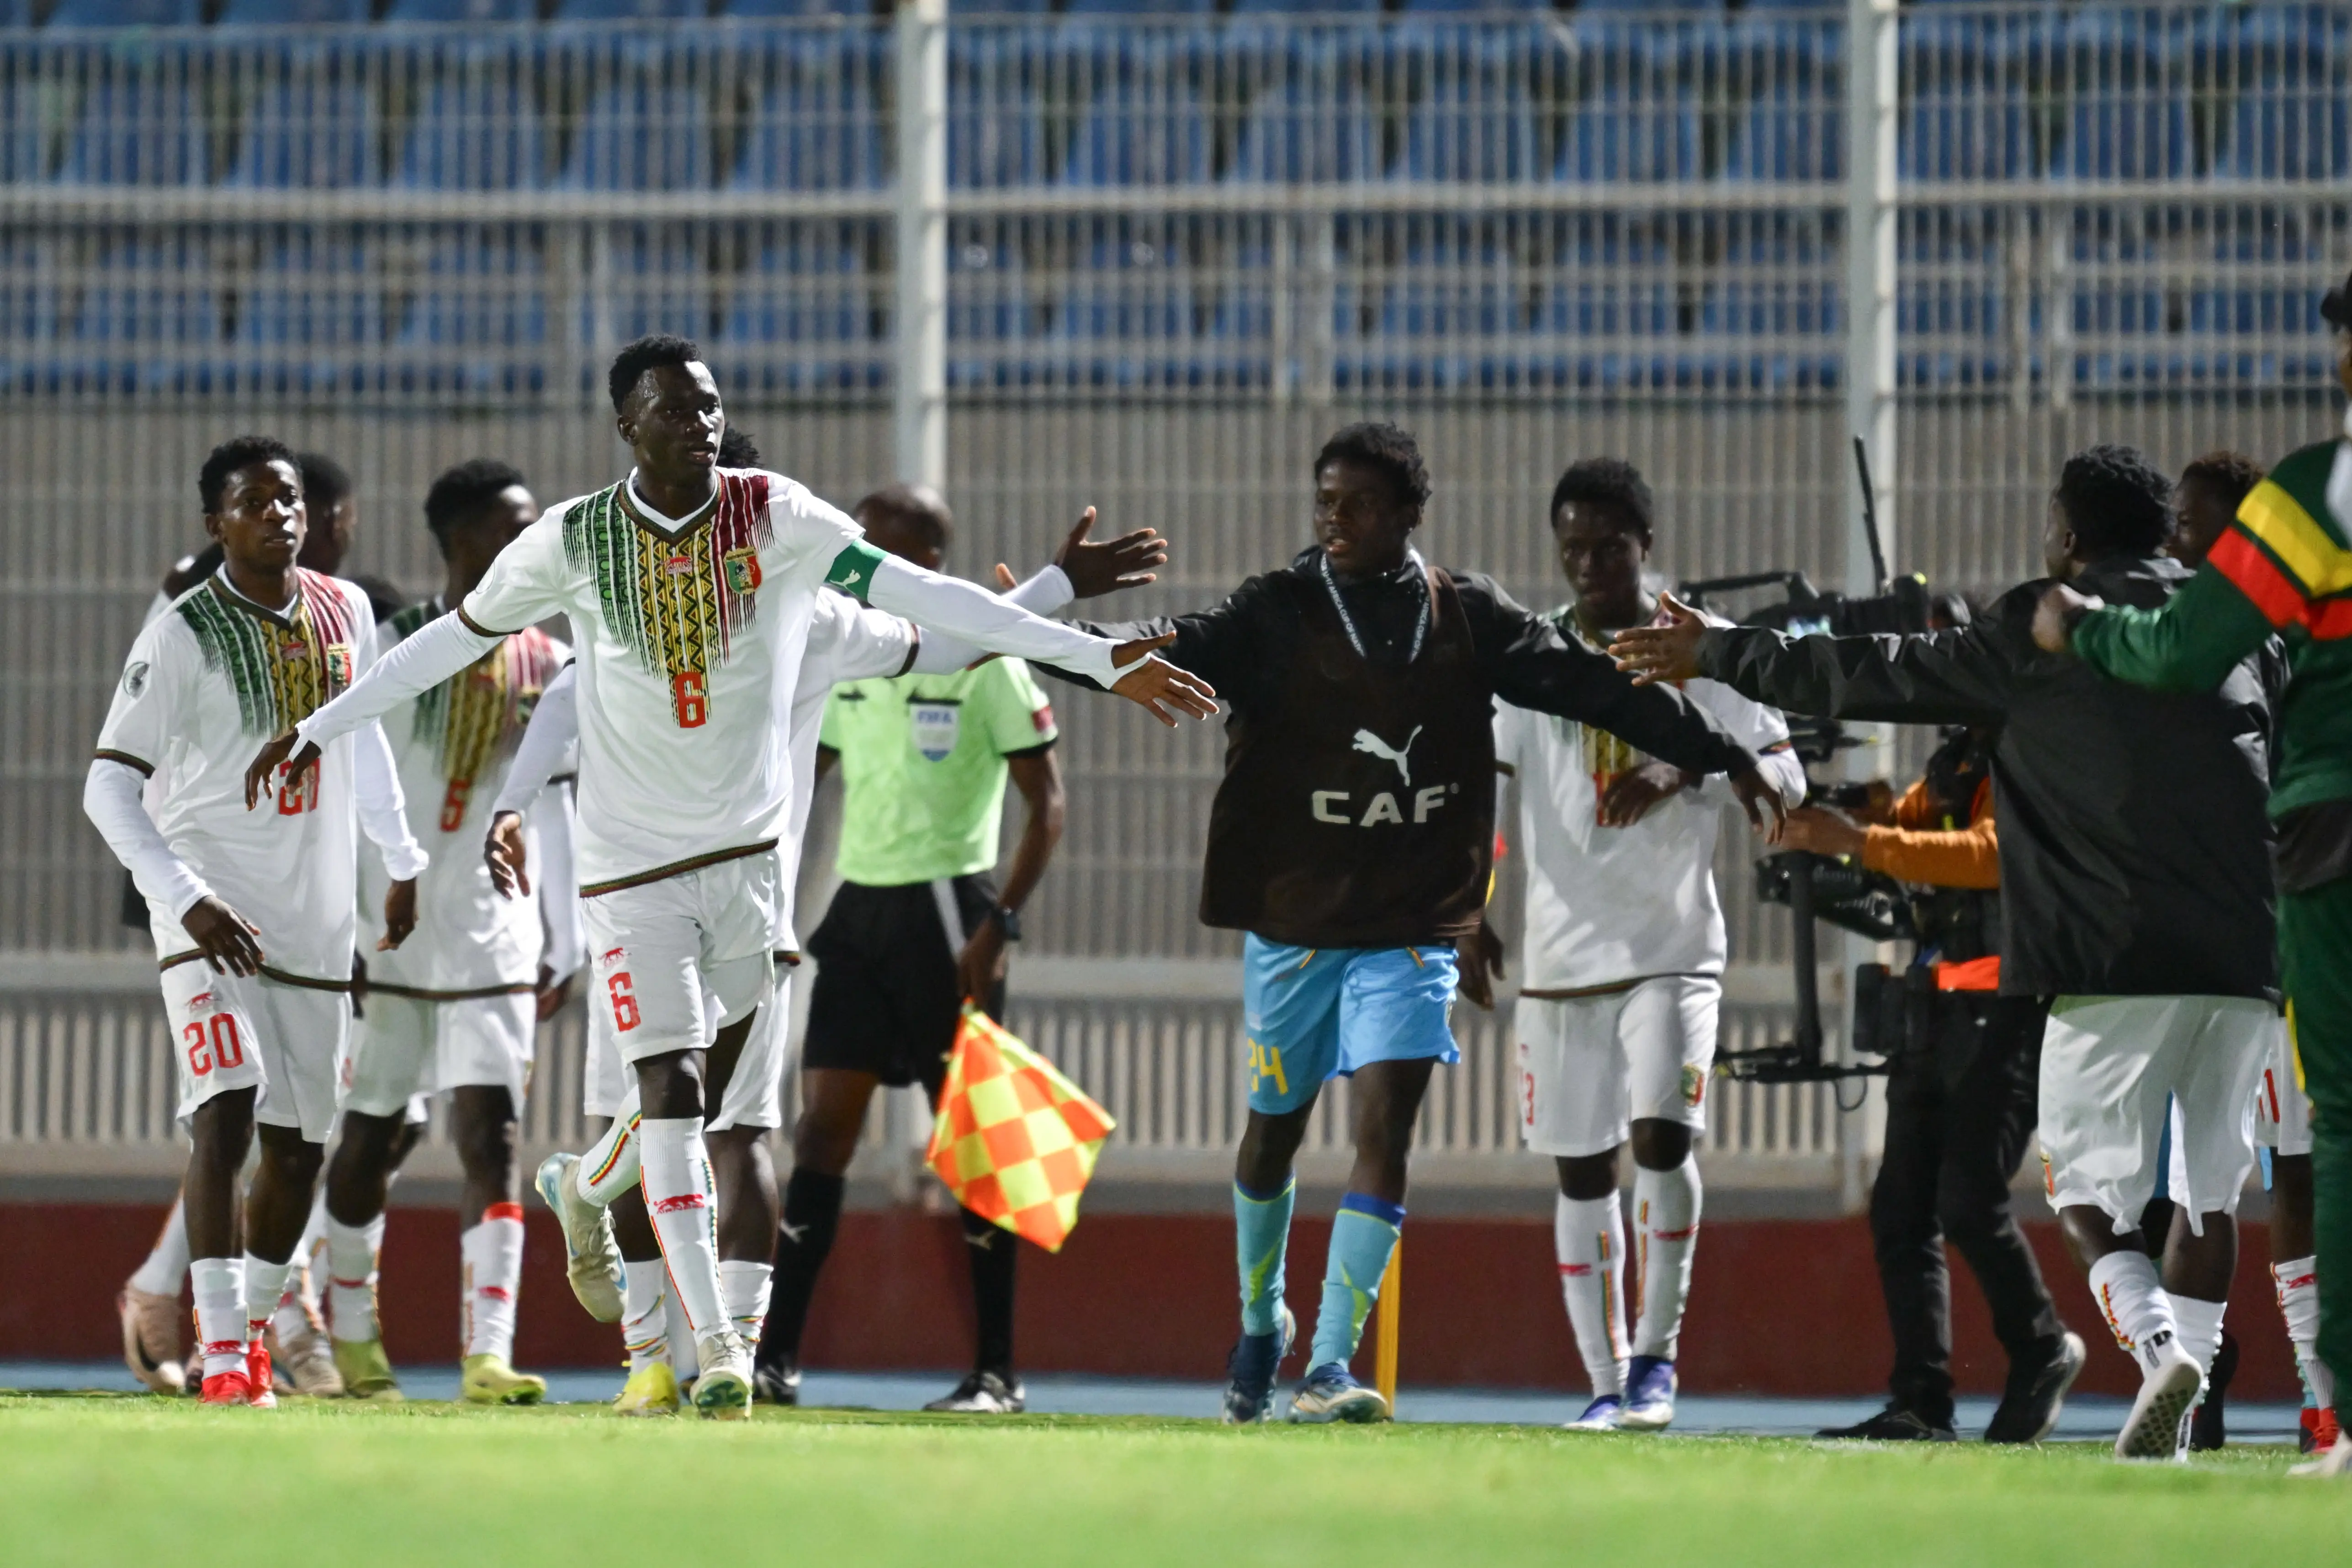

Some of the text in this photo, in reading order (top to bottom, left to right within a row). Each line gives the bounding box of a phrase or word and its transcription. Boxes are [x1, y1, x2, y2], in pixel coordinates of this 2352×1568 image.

[1329, 587, 1343, 610] AFRICA
[1340, 609, 1350, 623] CUP
[1346, 623, 1355, 633] OF
[674, 672, 706, 728] 6
[918, 710, 952, 723] FIFA
[440, 779, 474, 833] 5
[1311, 784, 1446, 827] CAF
[608, 971, 641, 1032] 6
[183, 1012, 244, 1077] 20
